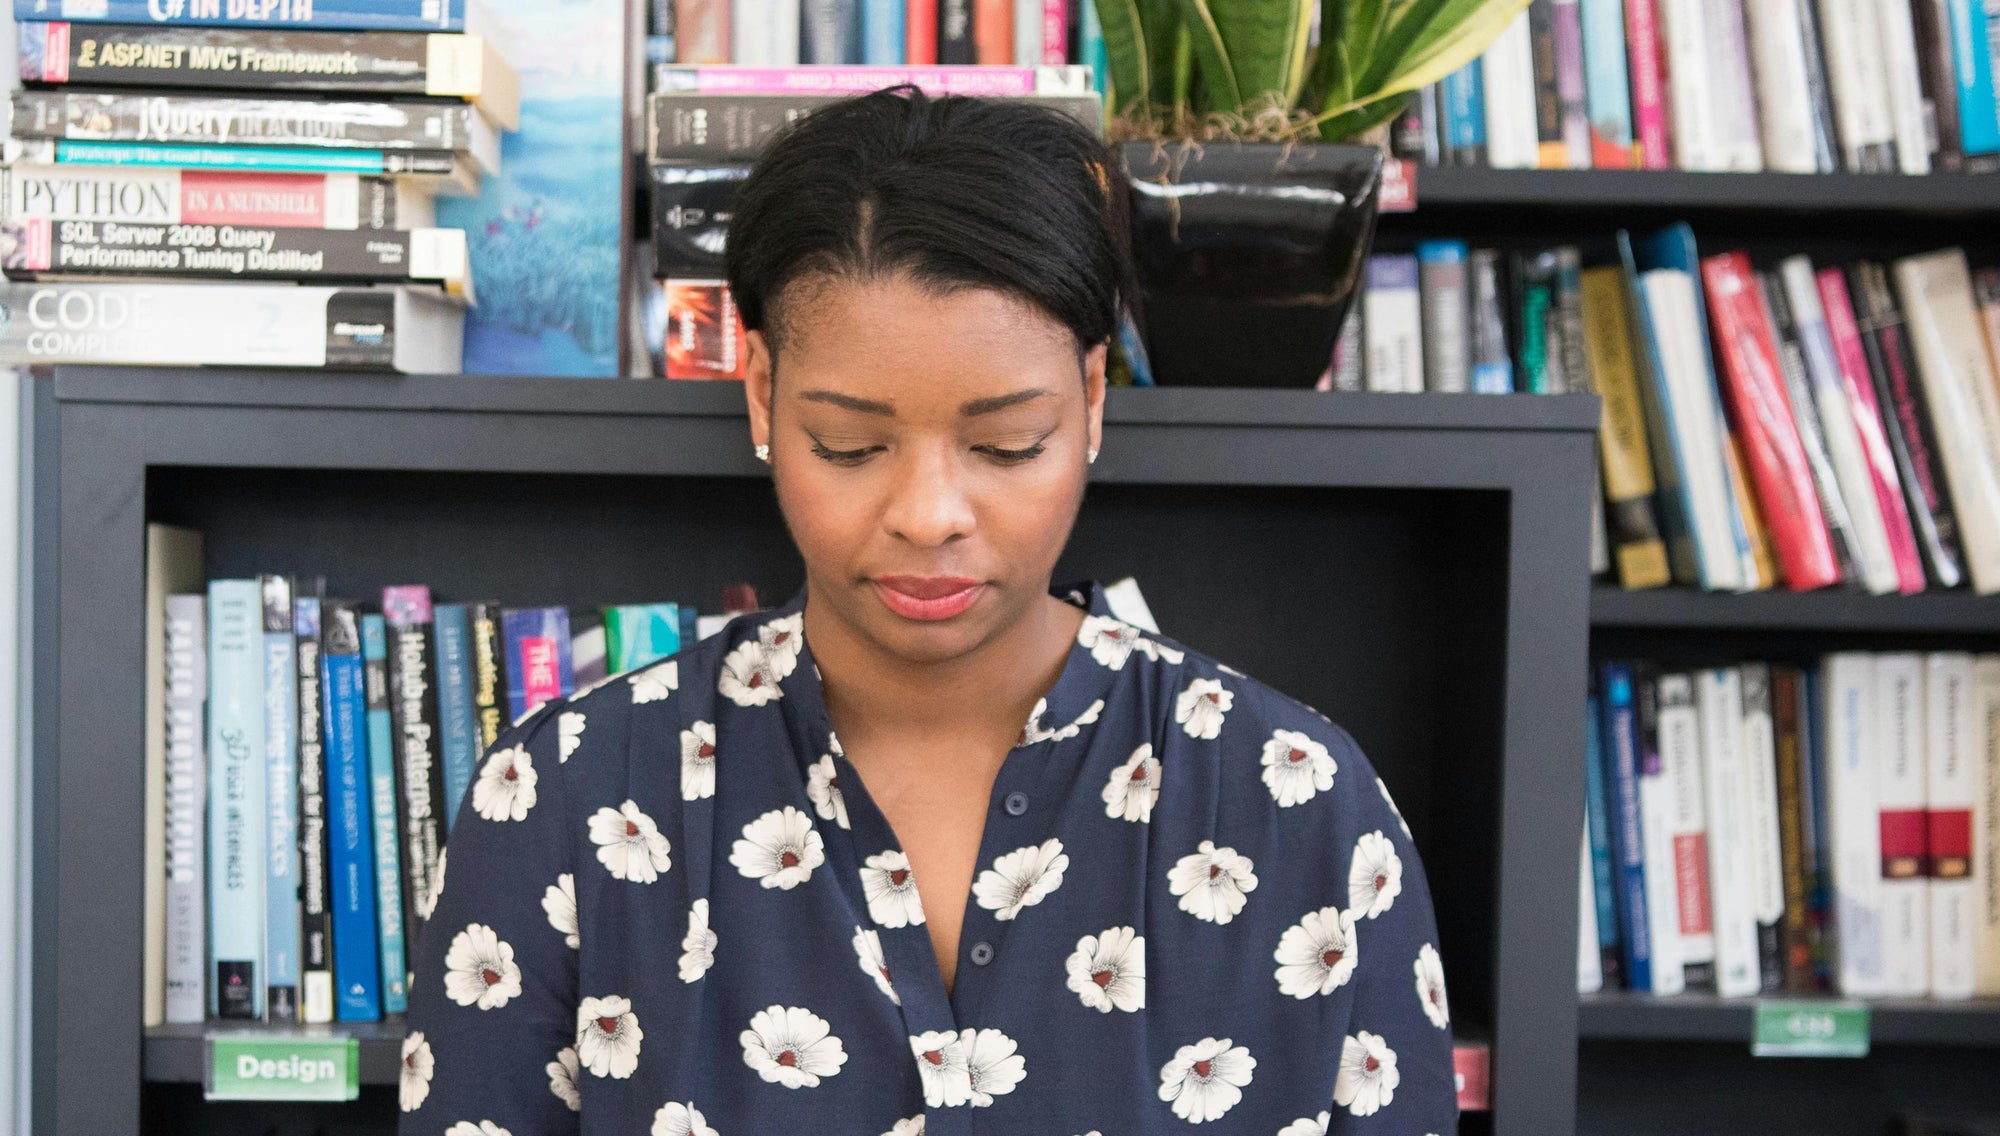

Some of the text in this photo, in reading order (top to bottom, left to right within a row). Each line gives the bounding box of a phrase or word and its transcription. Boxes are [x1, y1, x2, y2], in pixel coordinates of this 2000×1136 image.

[190, 0, 220, 19] IN
[226, 0, 313, 21] DEPTH
[99, 42, 186, 69] ASP.NET
[188, 46, 238, 71] MVC
[240, 47, 358, 74] Framework
[22, 179, 170, 216] PYTHON
[211, 192, 226, 211] A
[229, 192, 319, 213] NUTSHELL
[60, 221, 275, 252] SQL Server 2008 Query
[60, 244, 323, 273] Performance Tuning Distilled
[28, 288, 153, 330] CODE
[299, 642, 319, 677] User
[400, 632, 428, 699] Holub
[528, 643, 553, 687] THE
[265, 641, 293, 877] Designing Interfaces
[300, 743, 322, 794] Design
[404, 723, 432, 818] Patterns
[378, 819, 396, 864] PAGE
[382, 869, 400, 936] DESIGN
[237, 1054, 335, 1083] Design
